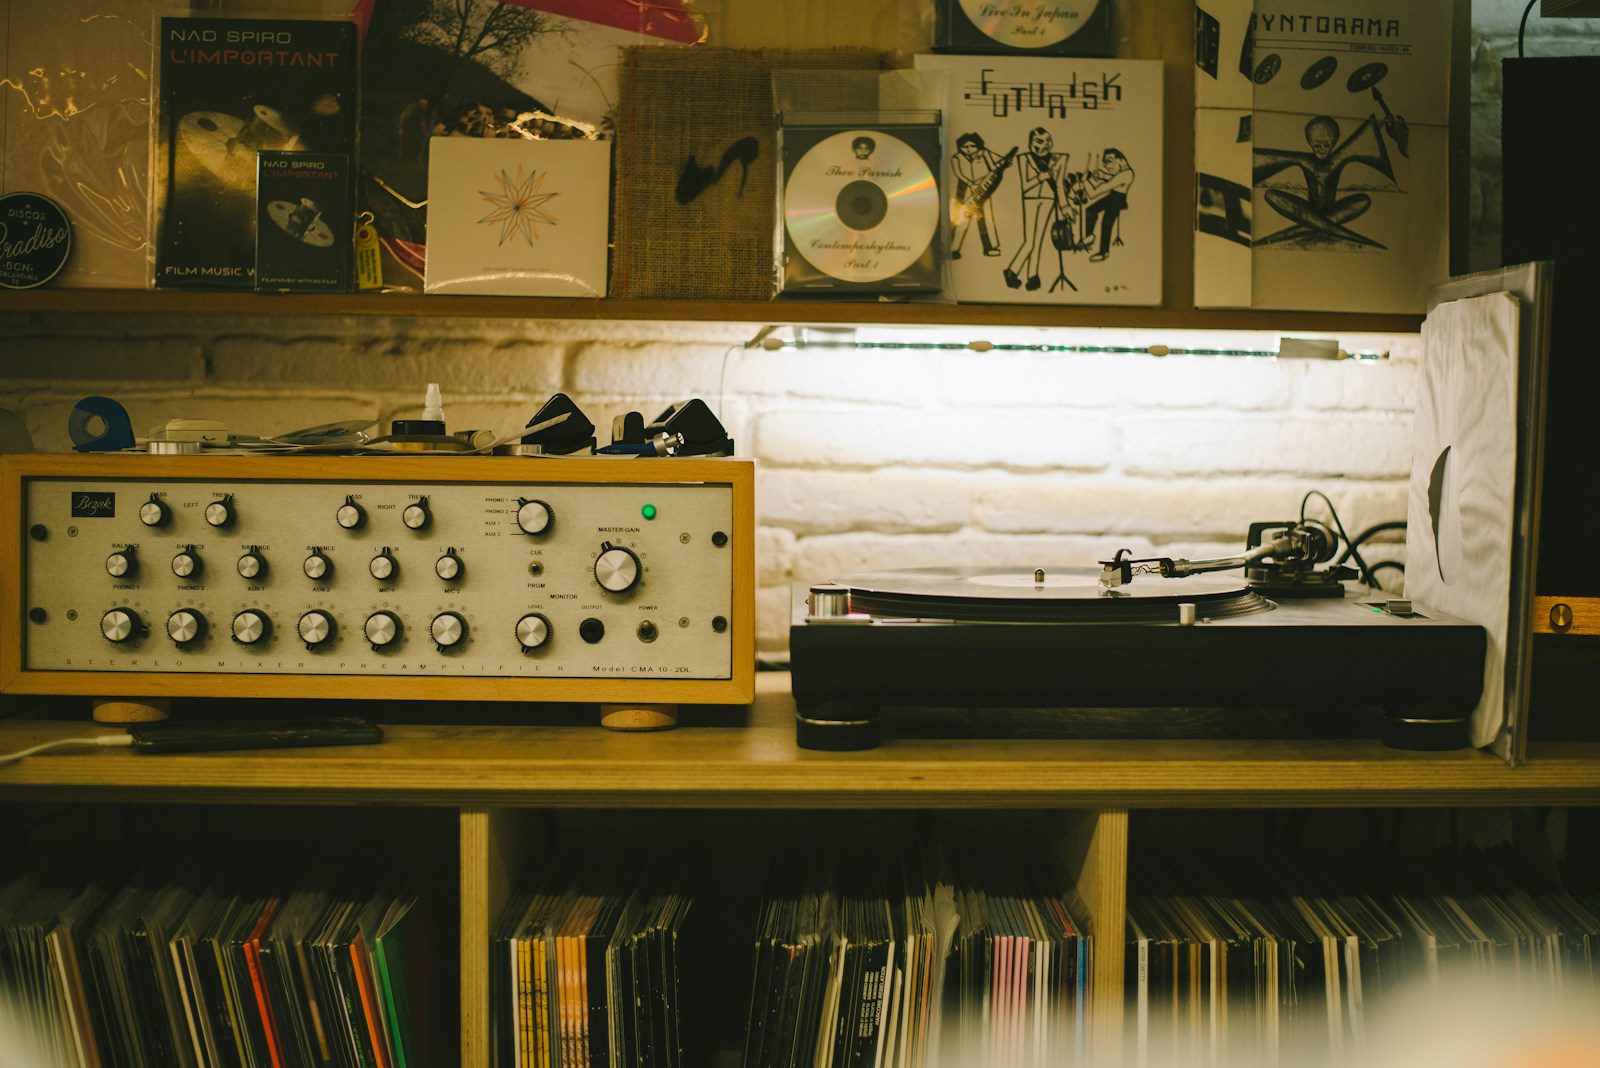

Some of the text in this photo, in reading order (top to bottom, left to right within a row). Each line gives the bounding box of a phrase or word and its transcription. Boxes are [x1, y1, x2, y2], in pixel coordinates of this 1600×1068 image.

[1034, 5, 1079, 22] Japan
[1251, 12, 1399, 37] YNTORAMA
[171, 30, 291, 44] NAD SPIRO
[171, 48, 338, 68] L'IMPORTANT
[264, 160, 325, 169] NAD SPIRO
[858, 166, 902, 178] Parrish
[8, 208, 47, 221] DISCOS
[165, 266, 198, 276] FILM
[201, 266, 242, 277] MUSIC
